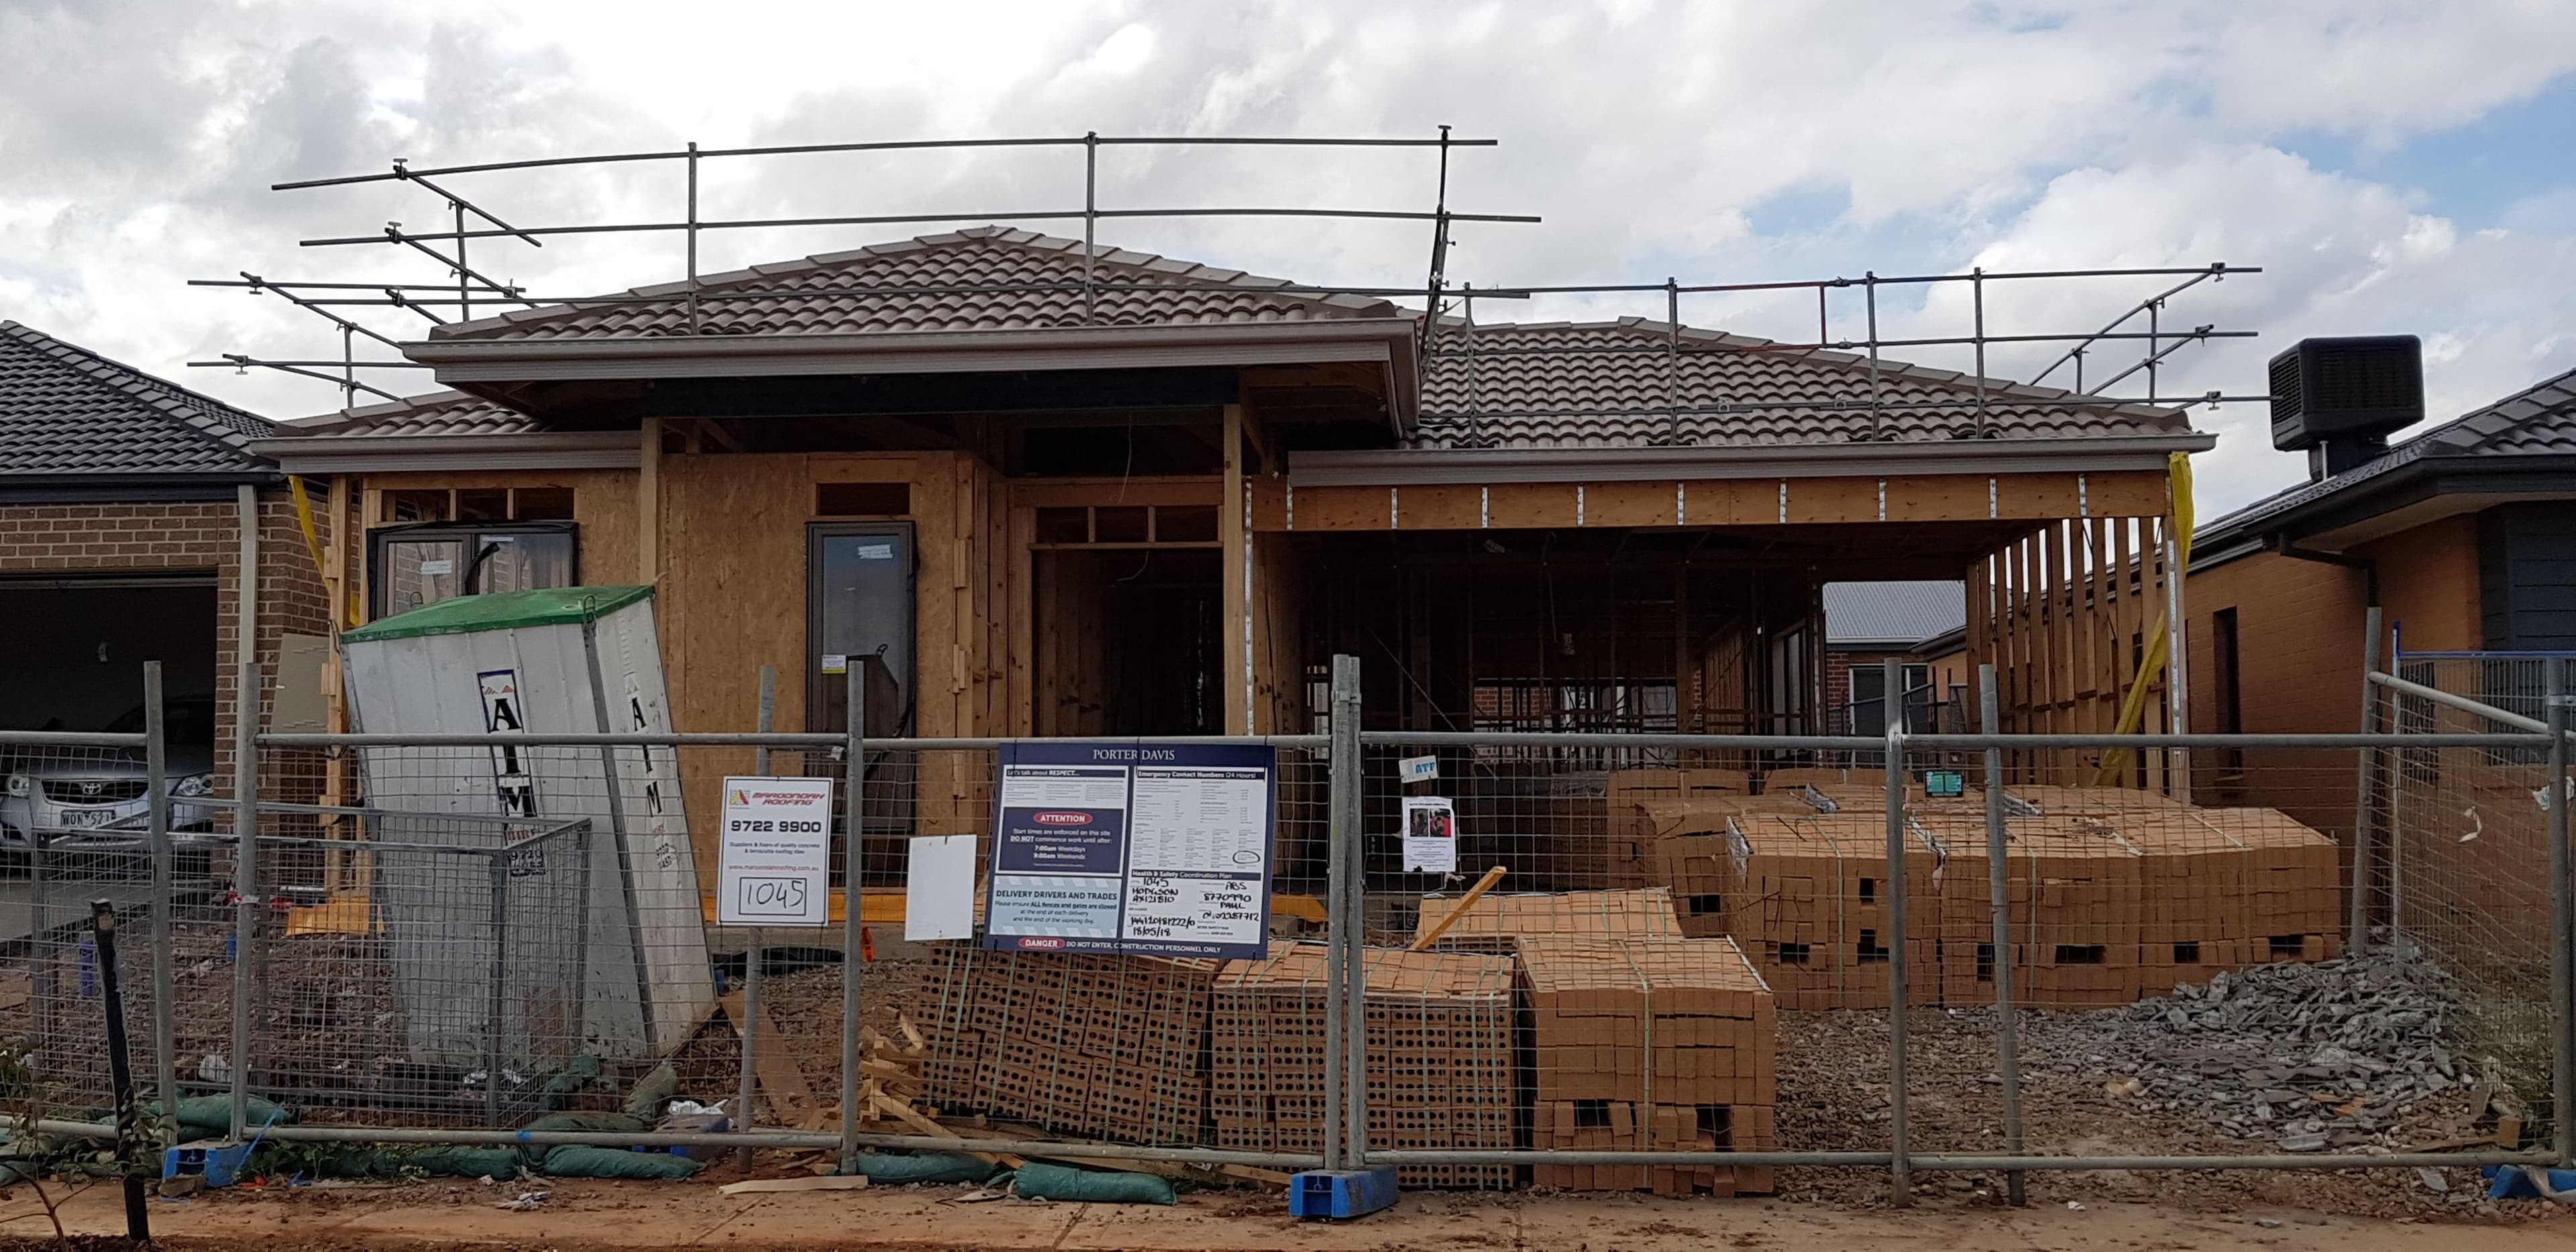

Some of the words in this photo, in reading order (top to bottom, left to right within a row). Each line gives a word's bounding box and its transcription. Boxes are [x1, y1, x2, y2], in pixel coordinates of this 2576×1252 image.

[1093, 749, 1138, 760] PORTER
[1141, 749, 1175, 760] DAVIS
[1138, 771, 1171, 779] Emergency
[731, 820, 773, 832] 9722
[779, 821, 822, 833] 9900
[1143, 877, 1169, 888] 1045
[747, 880, 804, 909] 1045
[996, 890, 1033, 899] DELIVERY
[1034, 891, 1067, 899] DRIVERS
[1068, 892, 1086, 900] AND
[1087, 892, 1118, 901] TRADES
[1132, 887, 1179, 896] HODGSON
[1220, 901, 1246, 910] PAUL
[1132, 926, 1172, 937] 18/05/18
[1025, 939, 1059, 948] DANGER
[1114, 942, 1165, 951] CONSTRUCTION
[1165, 944, 1203, 952] PERSONNEL
[1203, 946, 1222, 954] ONLY
